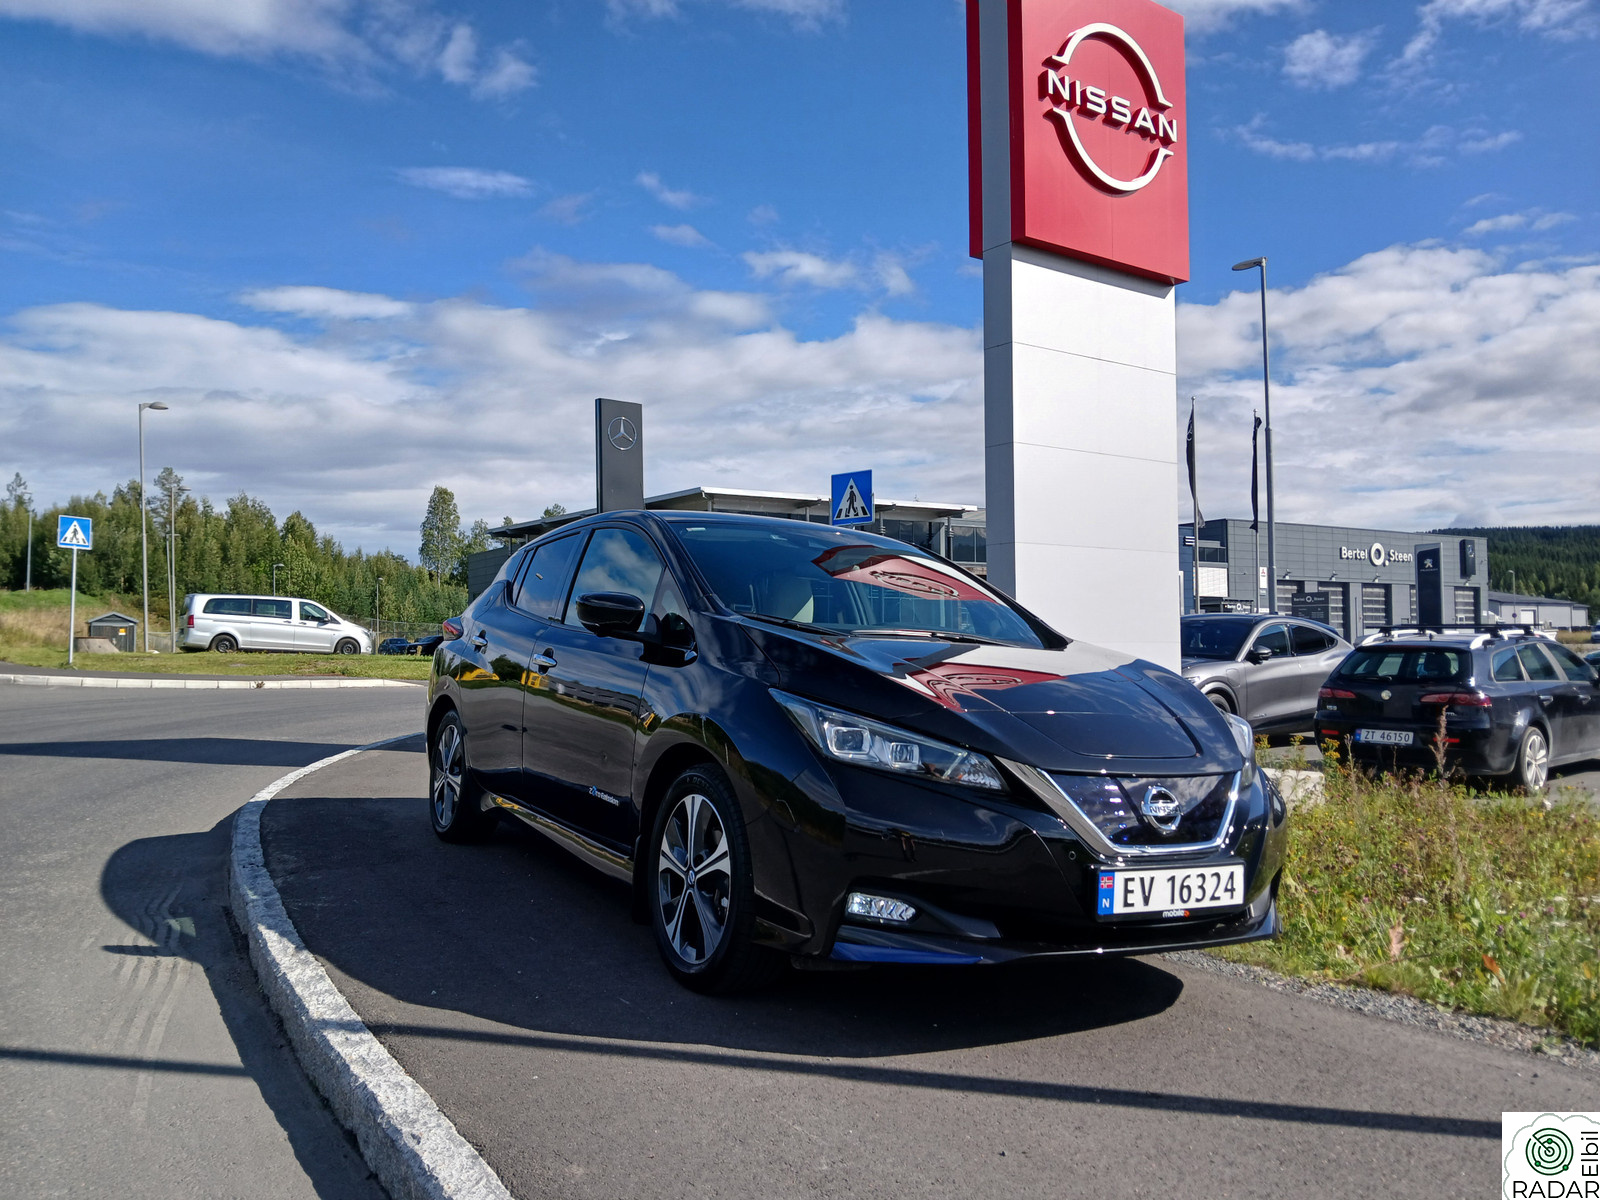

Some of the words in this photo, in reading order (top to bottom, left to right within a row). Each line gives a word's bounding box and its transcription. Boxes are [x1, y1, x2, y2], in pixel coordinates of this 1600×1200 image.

[1048, 69, 1178, 143] NISSAN
[1341, 546, 1368, 560] Bertel
[1389, 549, 1413, 562] Steen
[1364, 730, 1375, 740] ZT
[1380, 731, 1410, 742] 46150
[1122, 876, 1155, 908] EV
[1167, 871, 1236, 905] 16324
[1102, 898, 1110, 908] N
